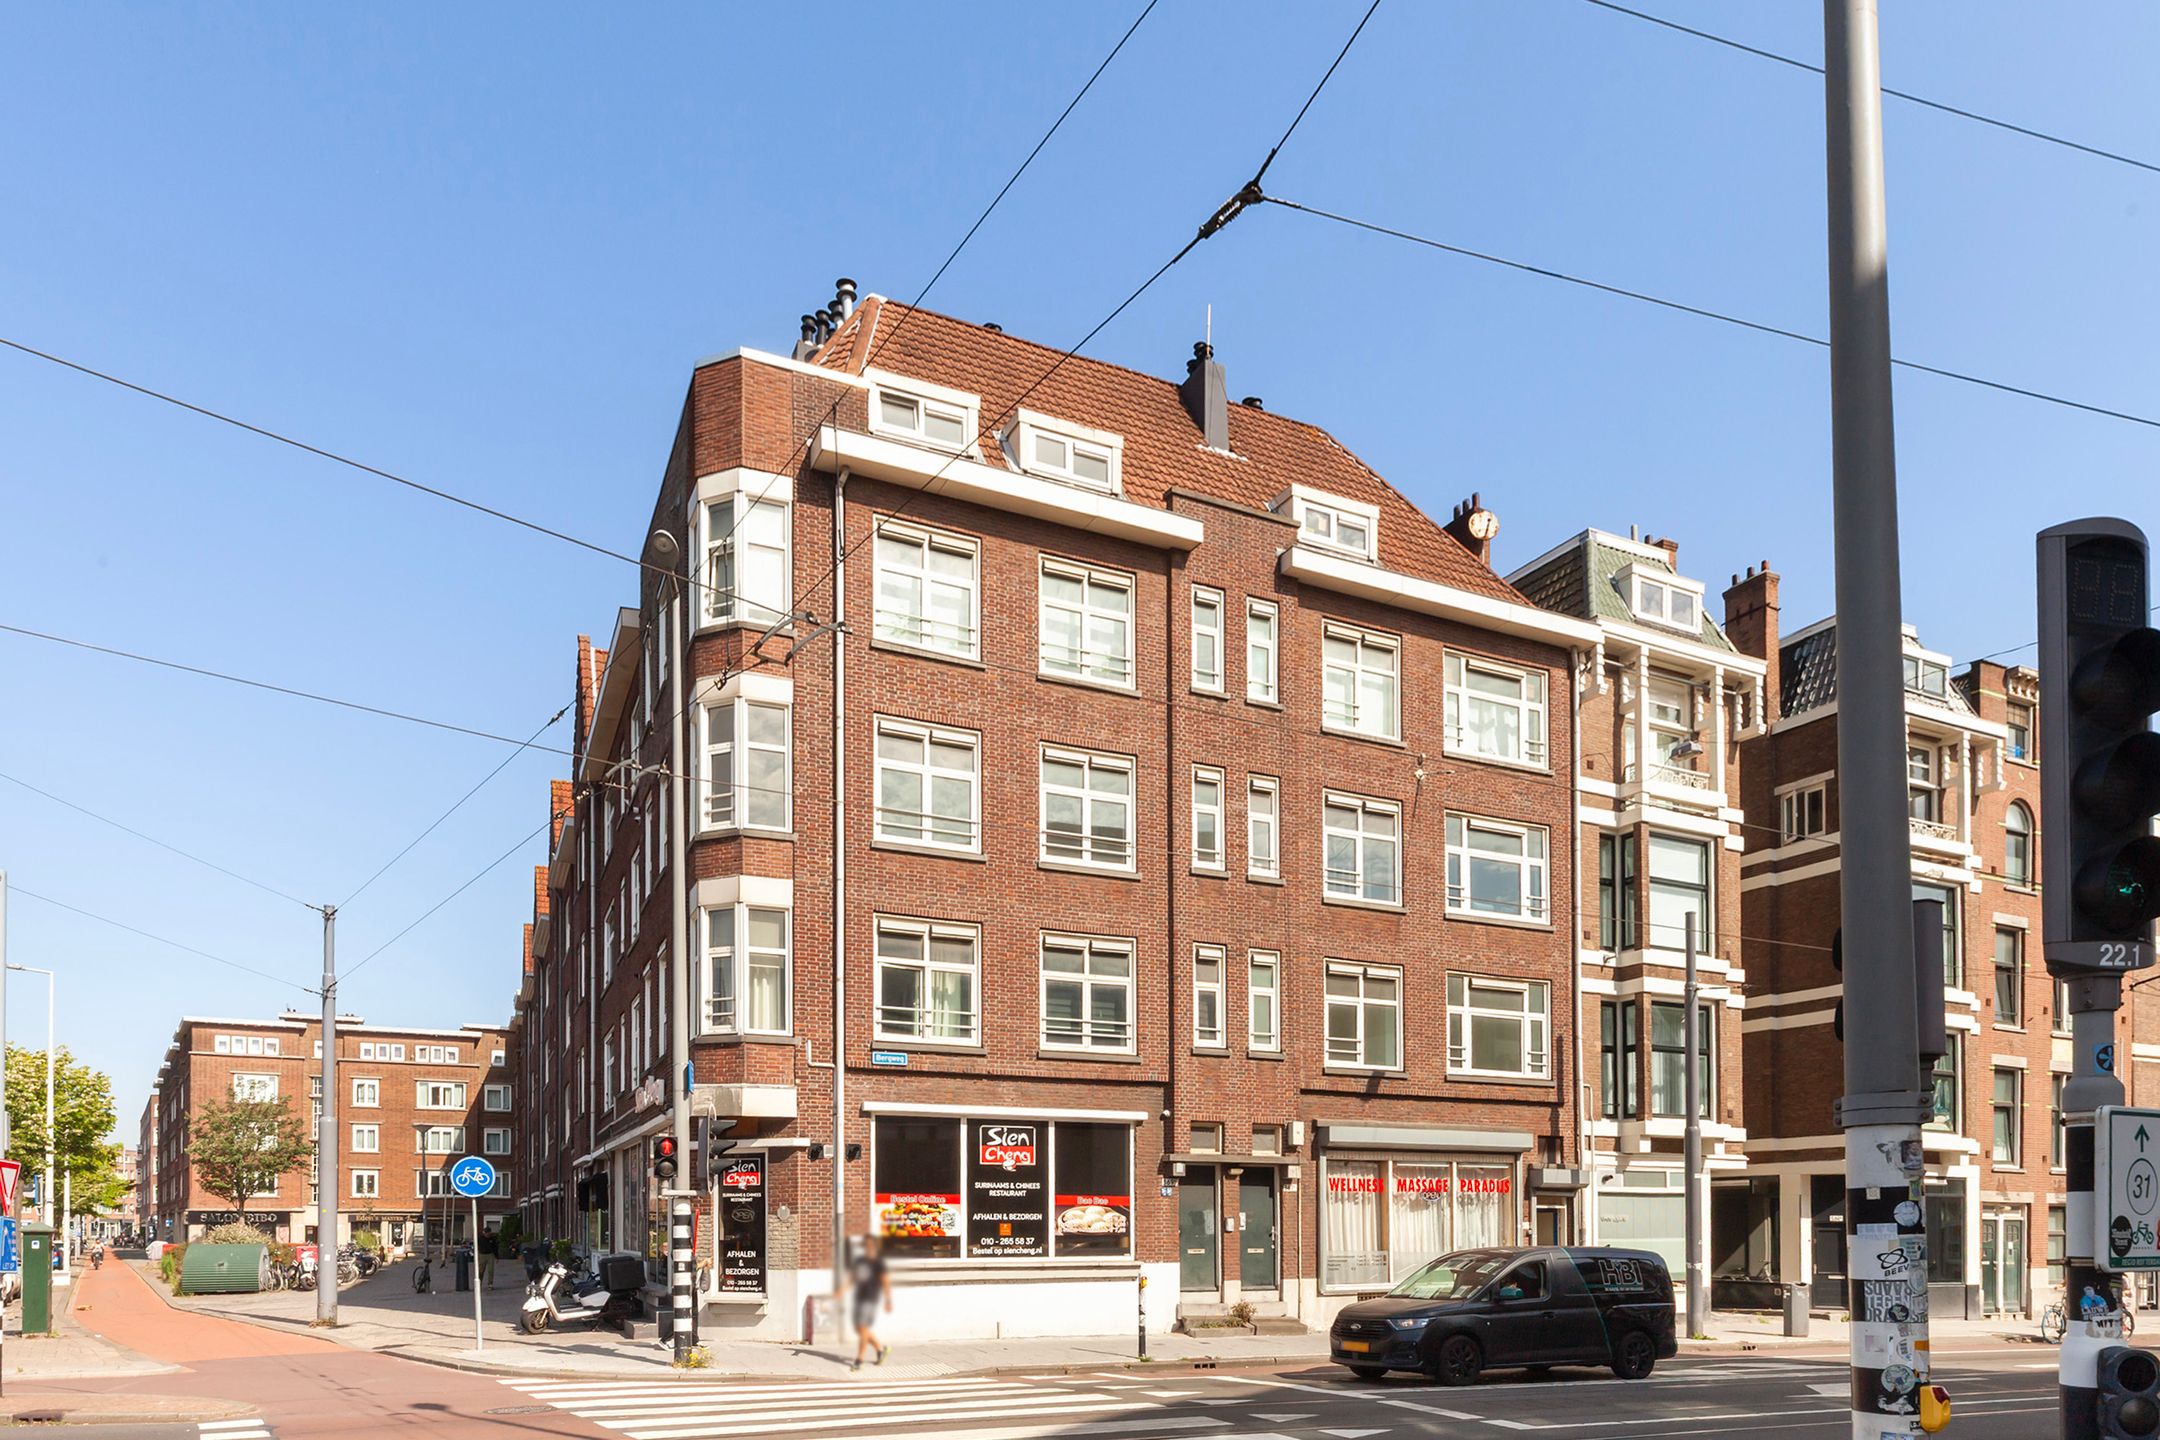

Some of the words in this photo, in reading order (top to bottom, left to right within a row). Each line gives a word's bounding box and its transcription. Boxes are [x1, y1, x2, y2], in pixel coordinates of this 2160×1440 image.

[2099, 943, 2140, 967] 22.1
[986, 1127, 1030, 1146] Sien
[985, 1146, 1031, 1164] Cheng
[726, 1173, 758, 1185] Cheng
[1329, 1177, 1384, 1193] WELLNESS
[1015, 1182, 1041, 1190] CHINEES
[1397, 1178, 1449, 1193] MASSAGE
[2133, 1174, 2151, 1199] 31
[1009, 1213, 1043, 1221] BEZORGEN
[980, 1237, 994, 1245] 010
[727, 1250, 756, 1258] AFHALEN
[972, 1247, 993, 1255] Bestel
[738, 1259, 744, 1267] &
[725, 1268, 760, 1276] BEZORGEN
[1598, 1259, 1644, 1285] HBI
[1884, 1264, 1910, 1277] BEEV
